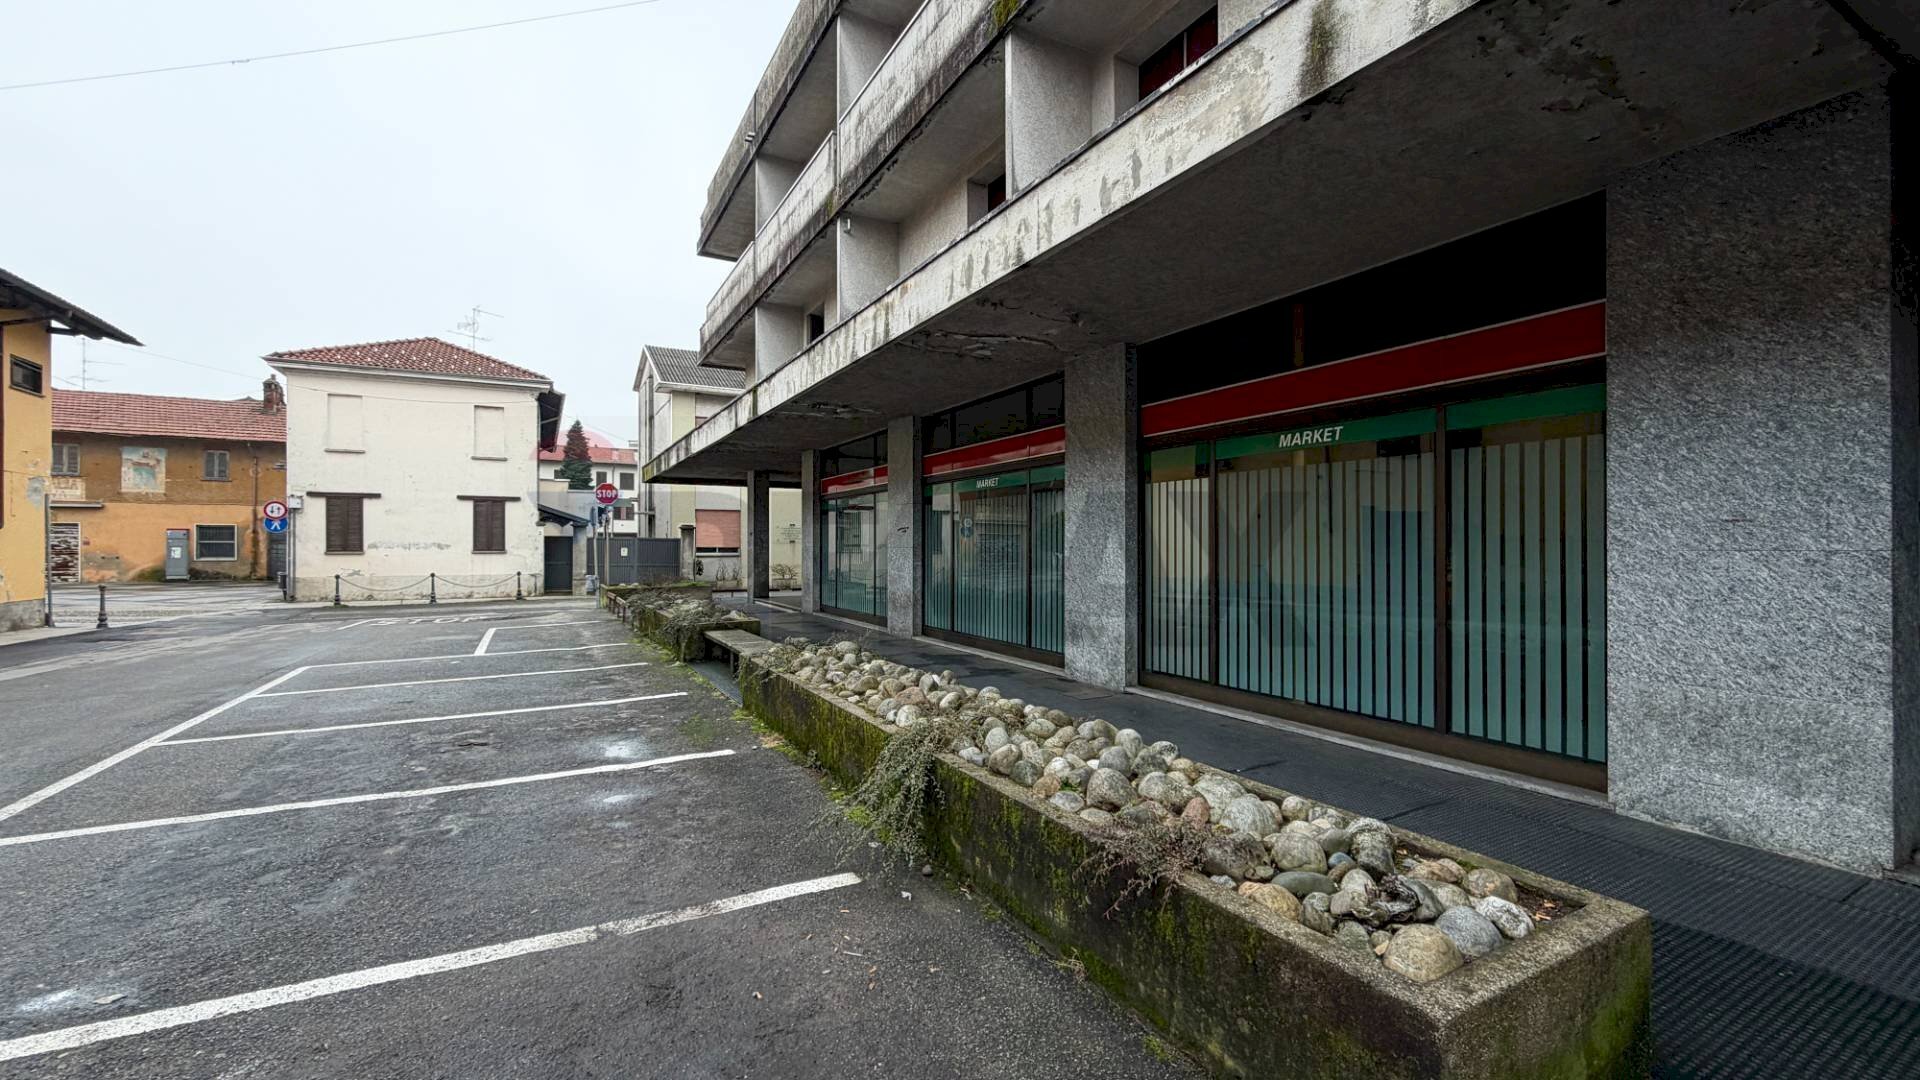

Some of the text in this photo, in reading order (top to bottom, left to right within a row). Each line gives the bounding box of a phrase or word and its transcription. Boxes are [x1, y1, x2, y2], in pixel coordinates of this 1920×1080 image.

[1279, 426, 1344, 448] MARKET
[976, 477, 999, 488] MARKET
[596, 489, 617, 498] STOP
